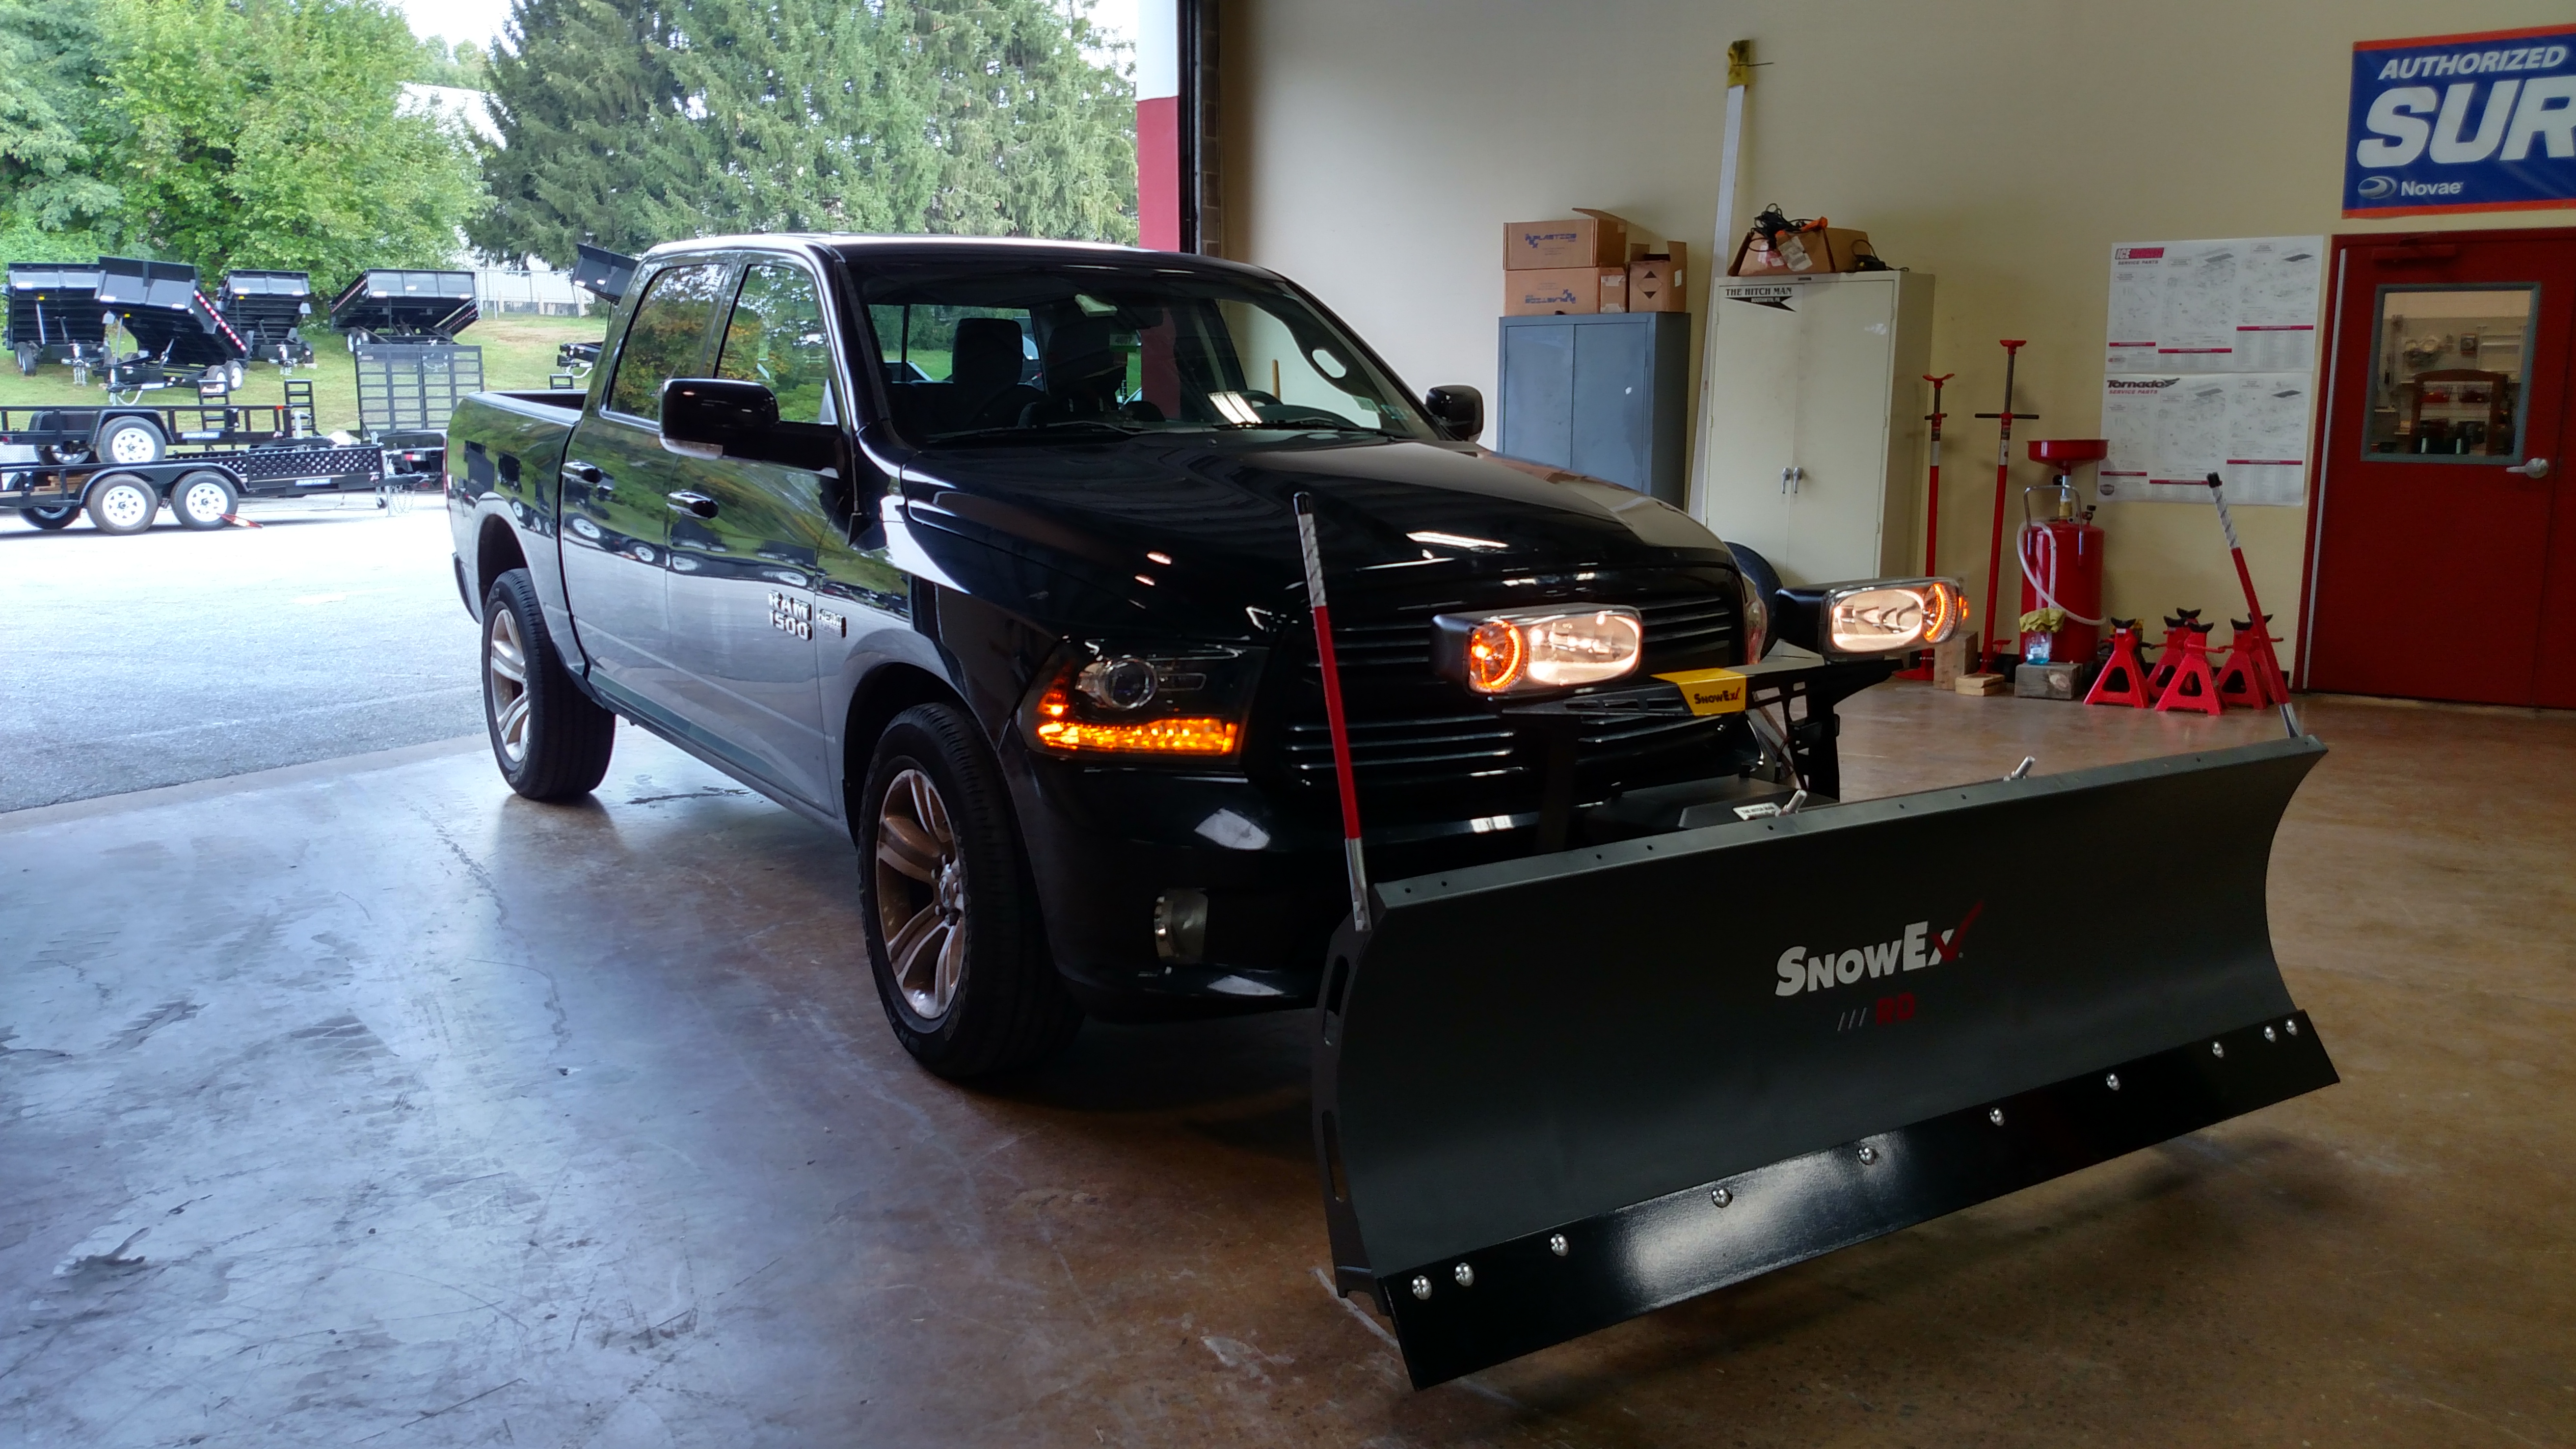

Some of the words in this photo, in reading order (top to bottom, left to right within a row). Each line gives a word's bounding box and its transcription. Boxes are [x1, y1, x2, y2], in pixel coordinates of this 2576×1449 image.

[2378, 47, 2566, 80] AUTHORIZED
[2357, 75, 2576, 168] SUR
[2401, 181, 2461, 196] Novae
[2116, 248, 2131, 259] ICE
[2107, 380, 2165, 388] Tornado
[768, 592, 811, 621] RAM
[769, 610, 812, 641] 1500
[1876, 992, 1915, 1025] RD
